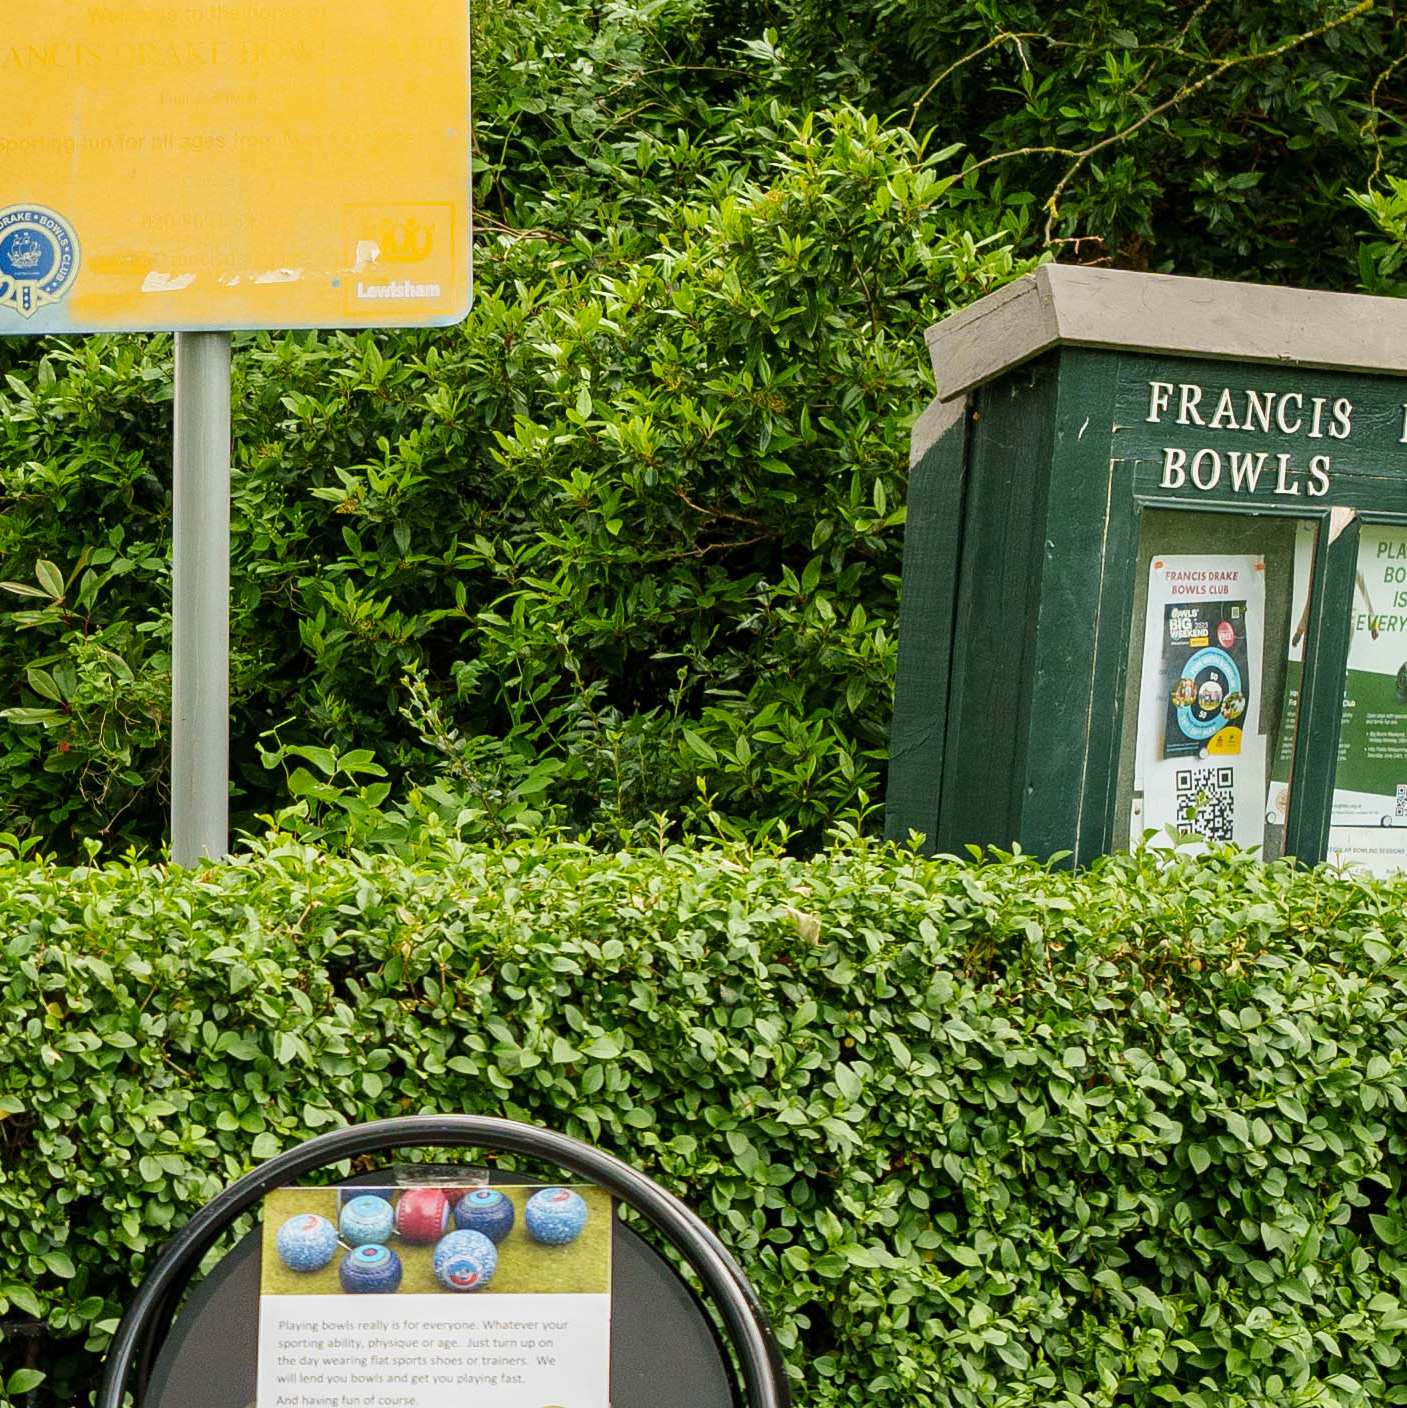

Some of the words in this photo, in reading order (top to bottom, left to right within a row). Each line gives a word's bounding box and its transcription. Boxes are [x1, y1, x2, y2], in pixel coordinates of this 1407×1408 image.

[40, 216, 69, 246] BOWLS
[56, 254, 71, 282] CLUB
[358, 280, 441, 299] Lewisham
[1145, 381, 1353, 440] FRANCIS
[1160, 447, 1330, 496] BOWLS
[1165, 571, 1206, 582] FRANCIS
[1208, 571, 1239, 581] DRAKE
[1171, 584, 1206, 595] BOWLS
[1208, 584, 1229, 595] CLUB
[277, 1319, 318, 1333] Playing
[321, 1319, 355, 1330] bowls
[357, 1319, 388, 1332] really
[391, 1321, 400, 1329] is
[402, 1319, 419, 1329] for
[421, 1321, 479, 1331] everyone.
[482, 1319, 539, 1330] Whatever
[541, 1321, 569, 1331] your
[277, 1338, 324, 1350] sporting
[326, 1337, 364, 1349] ability,
[367, 1337, 419, 1349] physique
[421, 1339, 434, 1348] or
[466, 1338, 489, 1347] Just
[492, 1338, 517, 1348] turn
[520, 1339, 536, 1348] up
[537, 1339, 553, 1348] on
[277, 1355, 296, 1366] the
[298, 1355, 319, 1367] day
[321, 1356, 367, 1367] wearing
[370, 1354, 389, 1365] flat
[392, 1356, 427, 1367] sports
[430, 1355, 463, 1365] shoes
[466, 1357, 478, 1365] or
[481, 1356, 529, 1366] trainers.
[536, 1355, 556, 1366] We
[276, 1372, 296, 1383] will
[299, 1372, 324, 1383] lend
[326, 1375, 347, 1384] you
[350, 1372, 383, 1383] bowls
[386, 1373, 408, 1383] and
[410, 1374, 429, 1385] get
[432, 1375, 453, 1384] you
[456, 1372, 498, 1386] playing
[500, 1372, 525, 1383] fast.
[275, 1394, 298, 1405] And
[301, 1395, 339, 1407] having
[341, 1394, 360, 1405] fun
[363, 1394, 375, 1405] of
